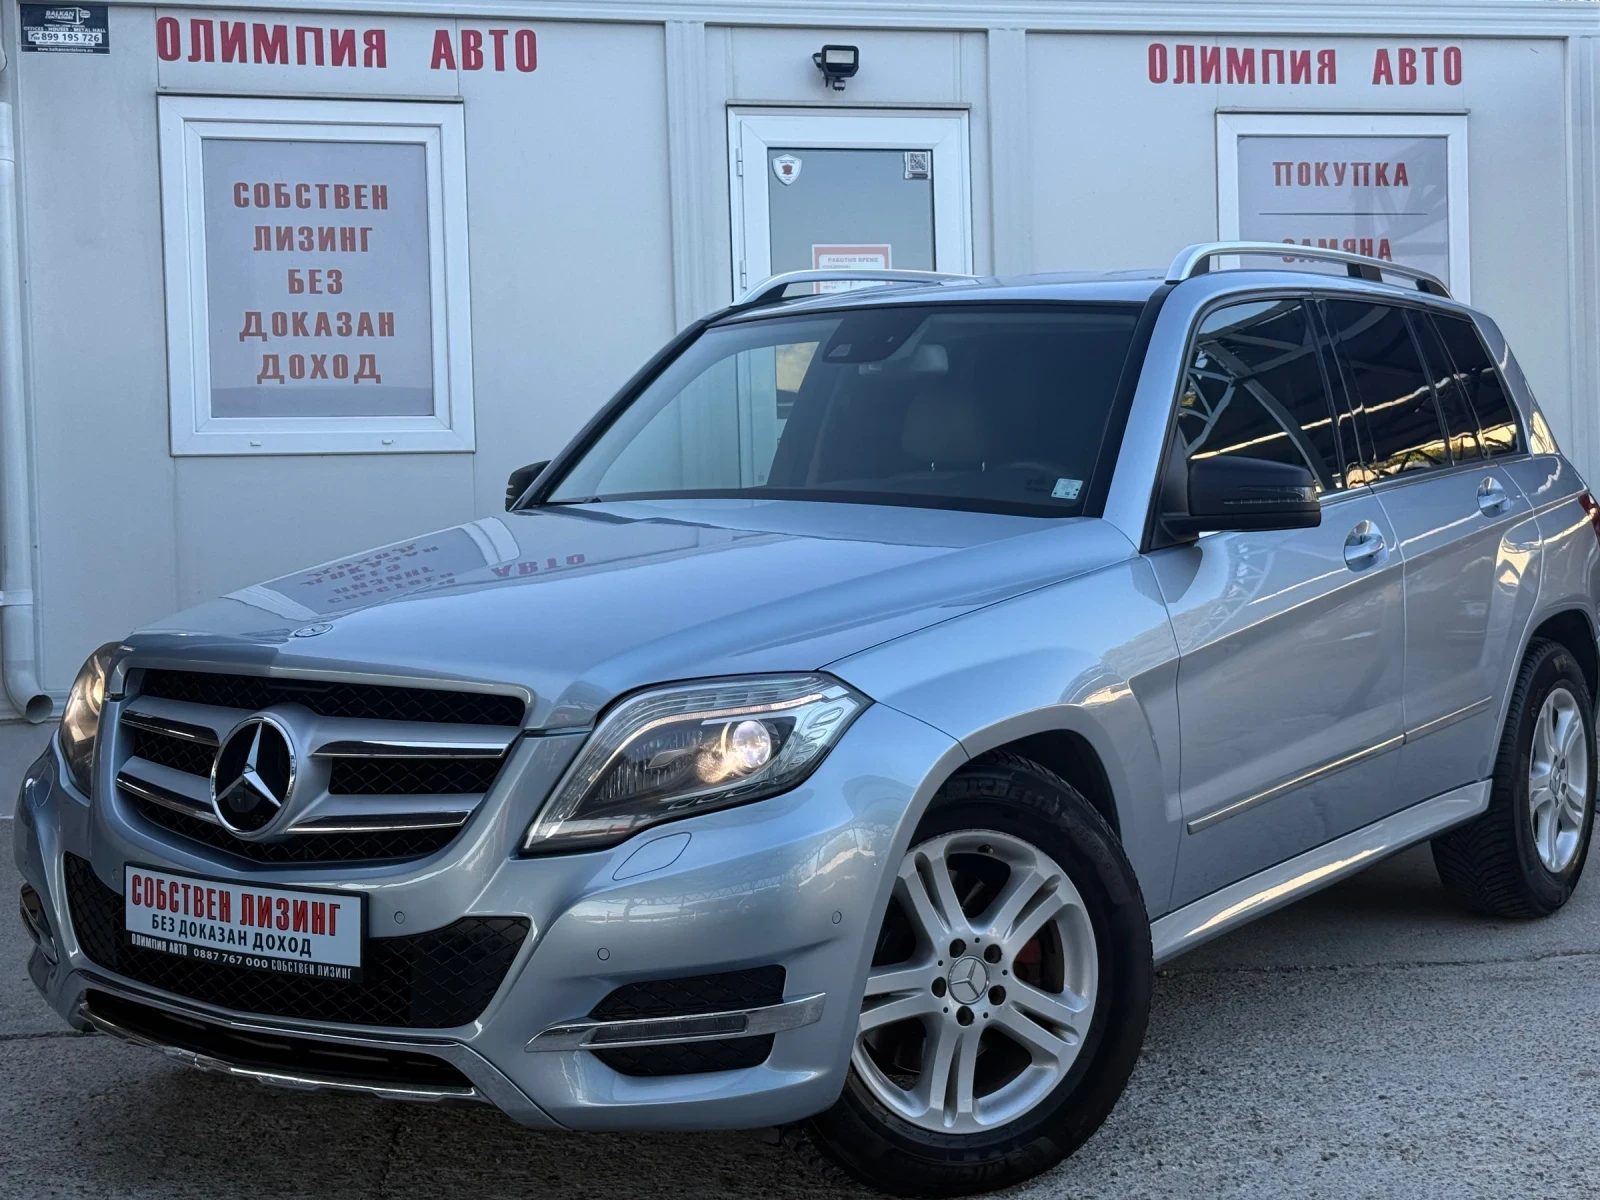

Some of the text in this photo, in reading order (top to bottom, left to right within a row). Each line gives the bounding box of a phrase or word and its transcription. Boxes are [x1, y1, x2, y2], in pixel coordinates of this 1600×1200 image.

[41, 32, 59, 41] 899
[62, 33, 79, 42] 195
[82, 33, 100, 42] 726
[157, 16, 538, 73] ОЛИМПИЯ АВТО
[1148, 43, 1463, 86] ОЛИМПИЯ АВТО
[1272, 161, 1409, 187] ПОКУПКА
[233, 182, 388, 210] СОБСТВЕН
[253, 225, 373, 252] ЛИЗИНГ
[288, 268, 343, 295] БЕЗ
[239, 311, 395, 342] ДОКАЗАН
[256, 354, 381, 384] ДОХОД
[131, 874, 341, 937] СОБСТВЕН ЛИЗИНГ
[152, 913, 312, 958] БЕЗ ДОКАЗАН ДОХОД
[131, 933, 352, 980] ОЛИМПИЯ АВТО 0887 767 000 СОБСТВЕН ЛИЗИНГ
